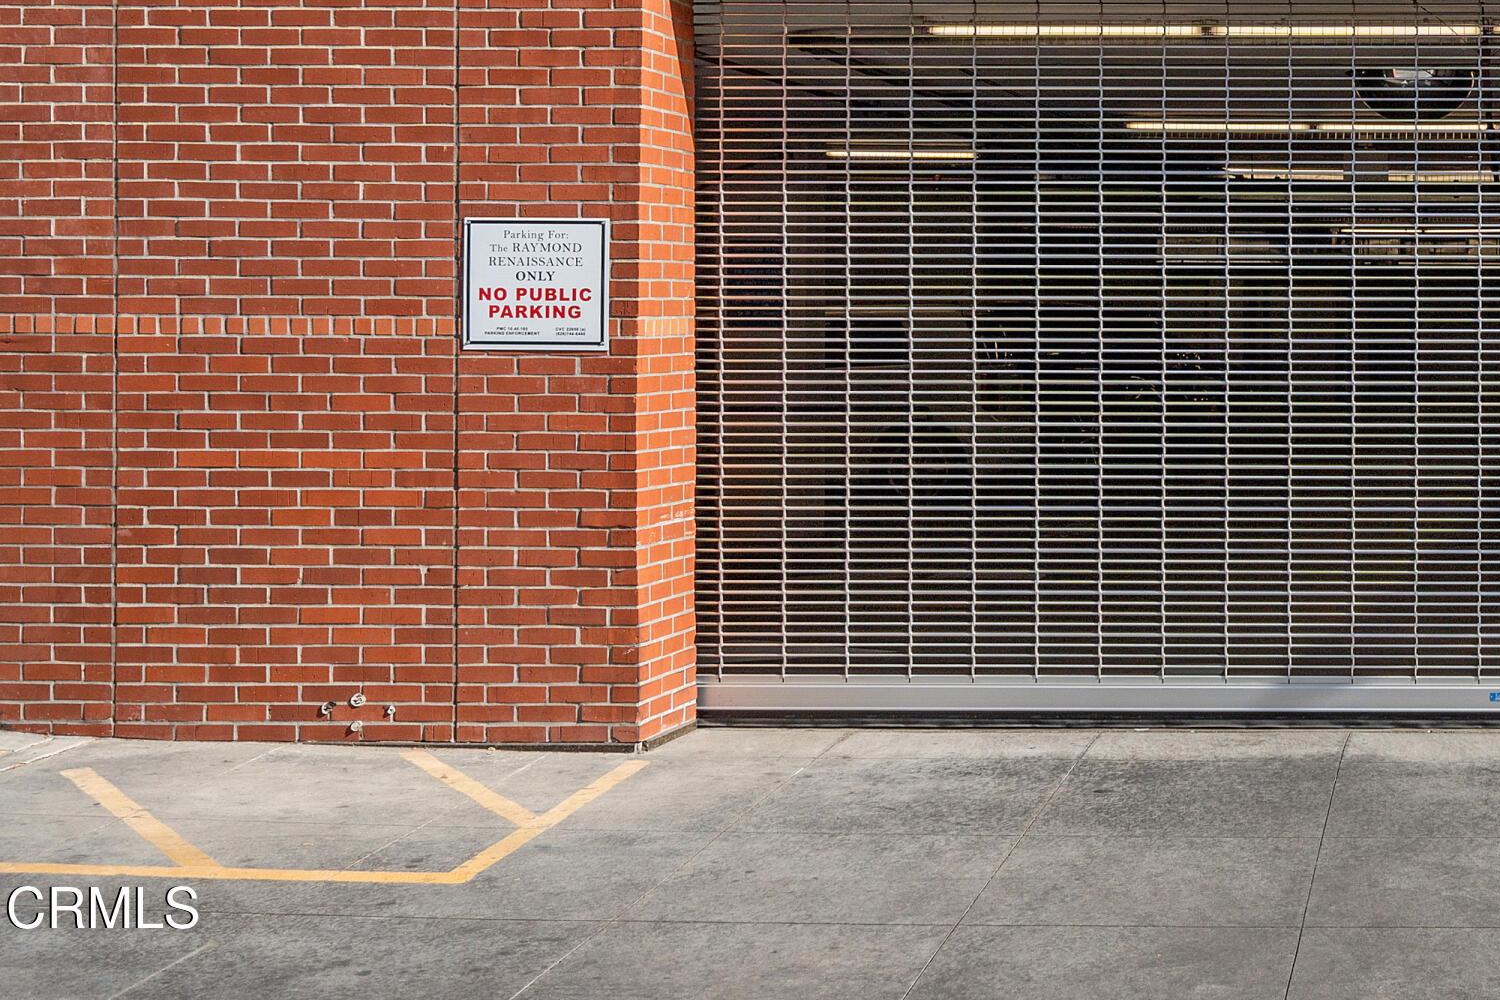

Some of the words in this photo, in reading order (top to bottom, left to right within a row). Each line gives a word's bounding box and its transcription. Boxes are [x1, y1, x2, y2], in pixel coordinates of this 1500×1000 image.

[503, 230, 544, 241] Parking
[548, 230, 569, 239] For:
[490, 243, 508, 253] The
[512, 242, 582, 253] RAYMOND
[488, 256, 583, 267] RENAISSANCE
[515, 271, 556, 281] ONLY
[479, 287, 507, 301] NO
[516, 287, 592, 302] PUBLIC
[488, 305, 582, 319] PARKING
